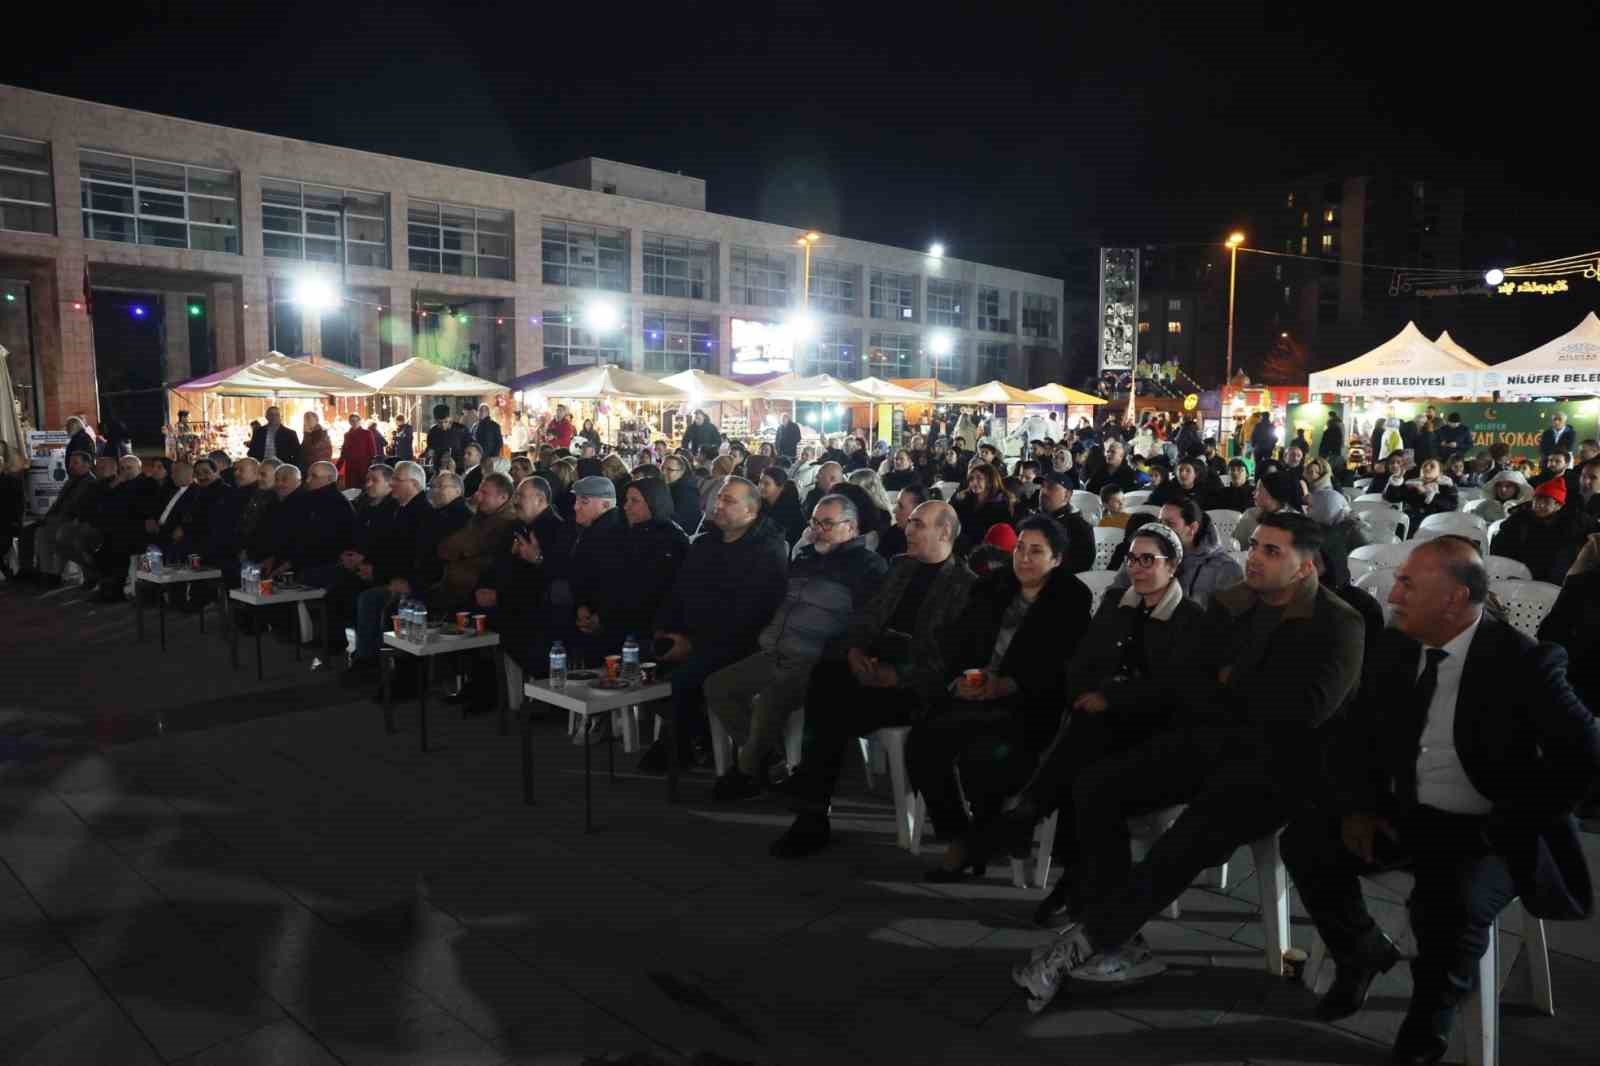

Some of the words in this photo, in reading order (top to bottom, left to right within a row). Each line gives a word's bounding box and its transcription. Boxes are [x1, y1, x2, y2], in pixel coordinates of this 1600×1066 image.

[1336, 376, 1379, 387] NİLÜFER
[1382, 375, 1445, 386] BELEDİYESİ
[1507, 372, 1560, 384] NİLÜFER
[1471, 431, 1494, 446] ZAN
[1499, 429, 1543, 447] SOKAĞ
